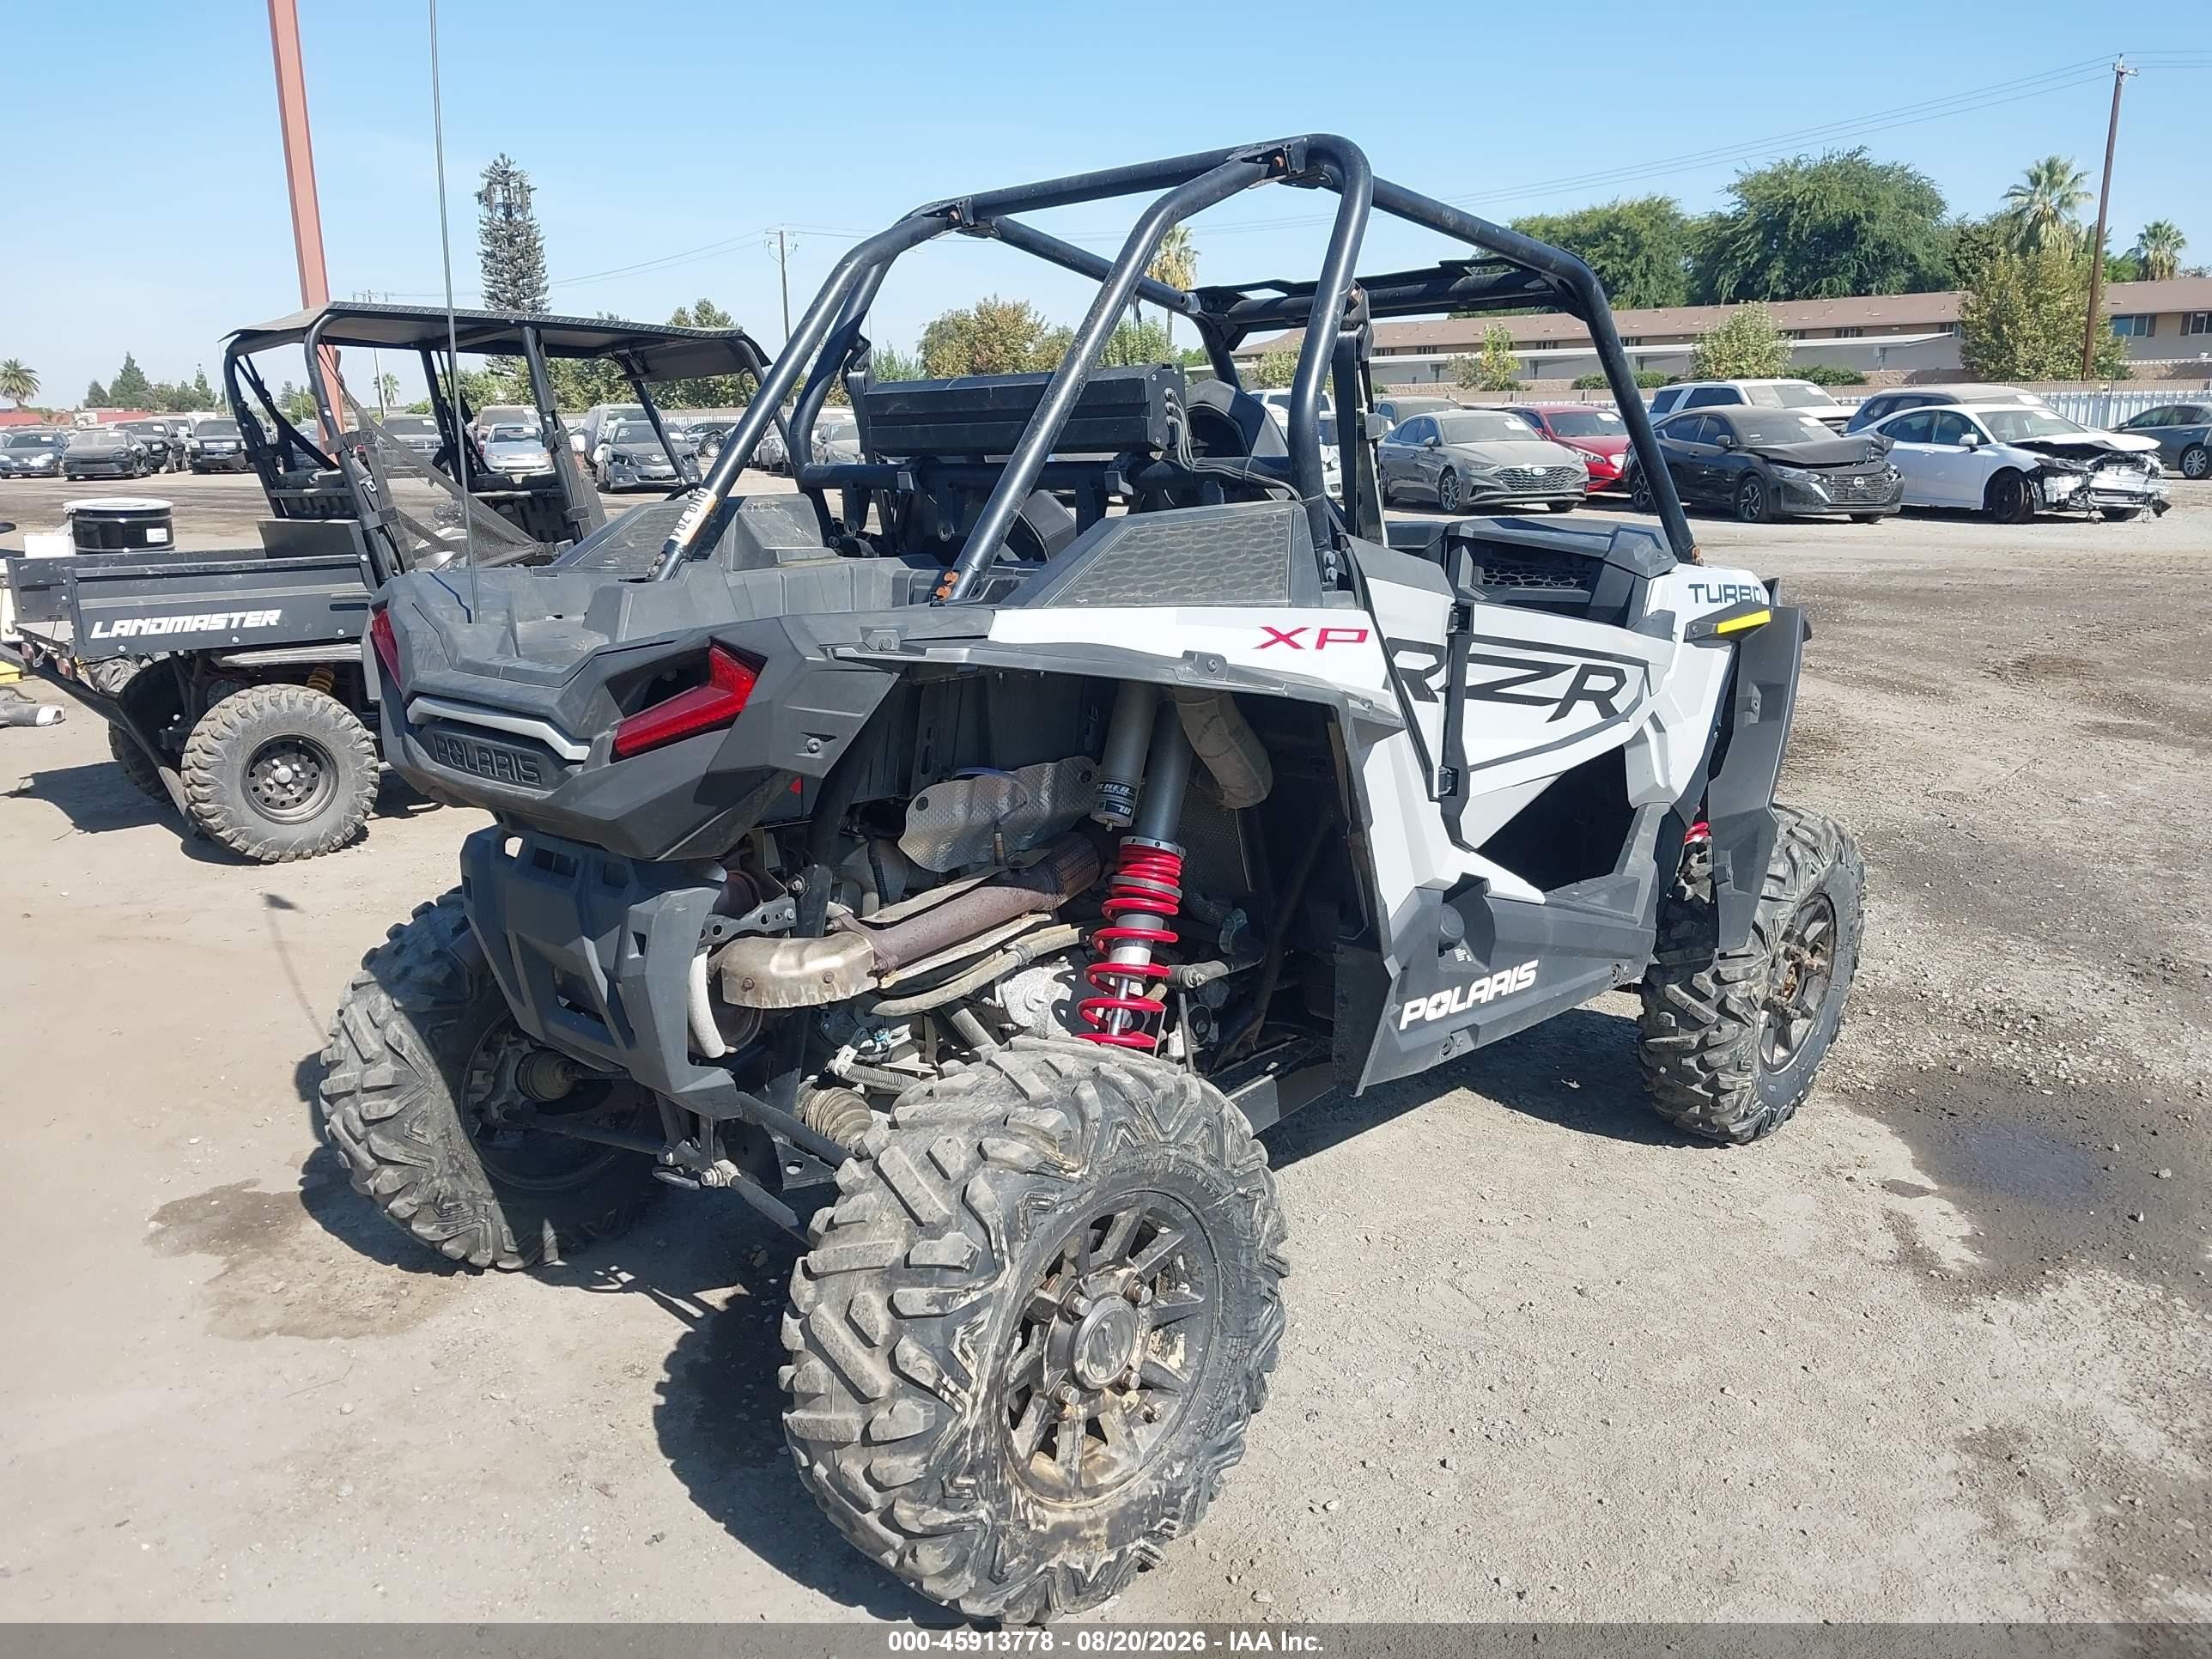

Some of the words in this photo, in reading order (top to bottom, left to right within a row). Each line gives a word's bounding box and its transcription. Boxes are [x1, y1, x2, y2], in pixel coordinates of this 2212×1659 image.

[1687, 583, 1763, 603] TURBO
[89, 609, 283, 639] LANDMASTER
[1251, 626, 1369, 650] XP
[1382, 636, 1631, 723] RZR
[432, 733, 542, 786] POLARIS
[1399, 959, 1539, 1030] POLARIS
